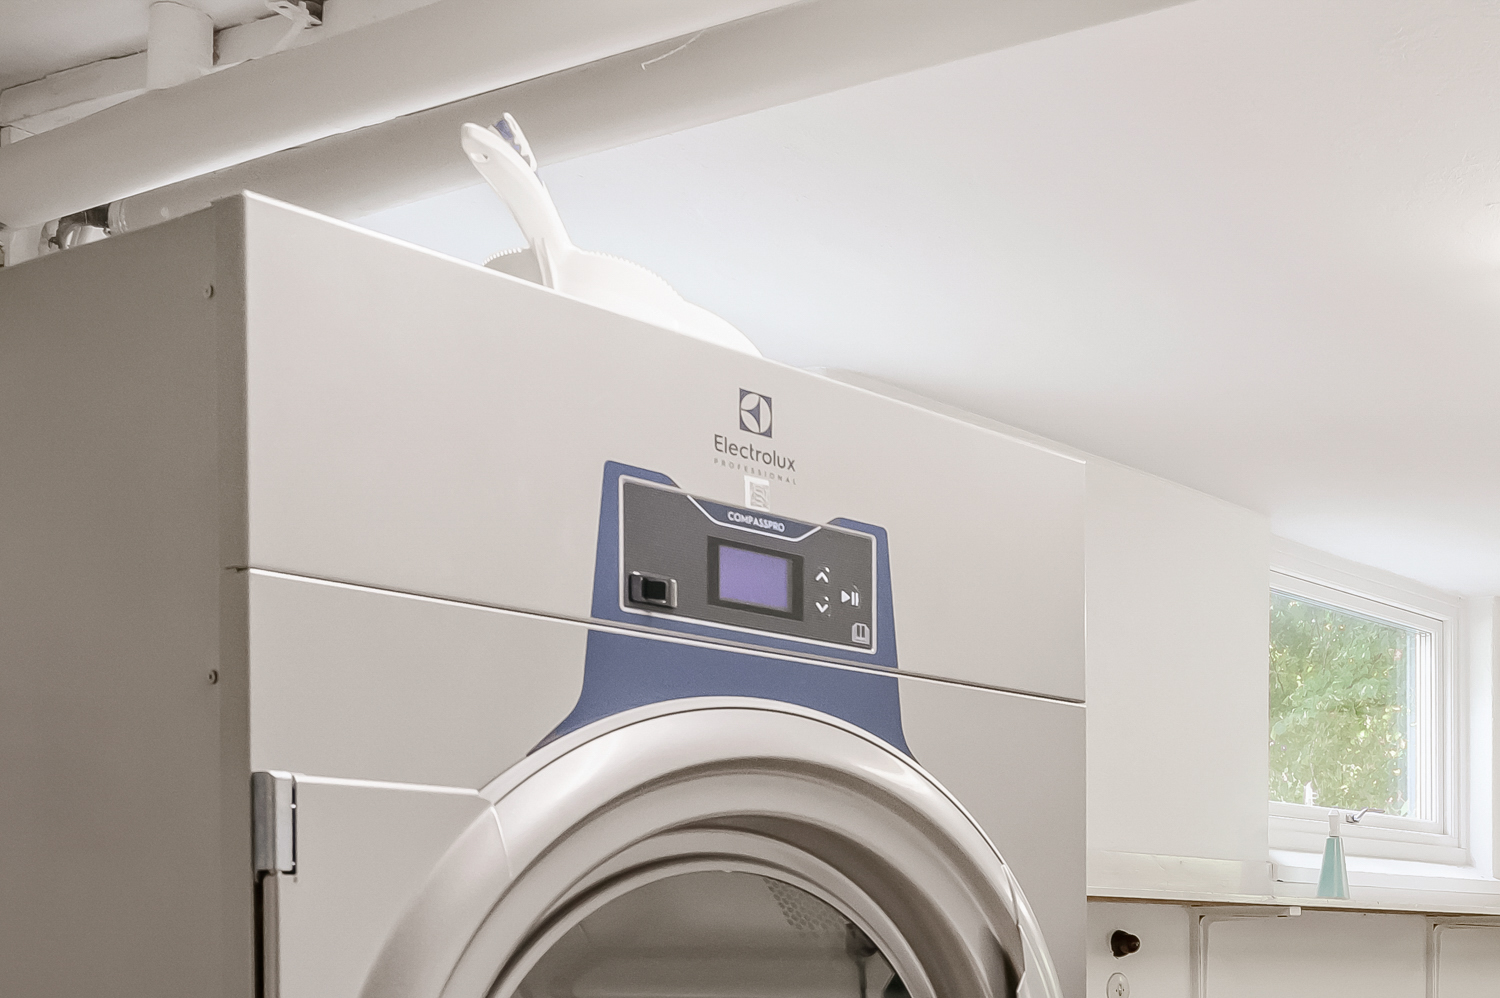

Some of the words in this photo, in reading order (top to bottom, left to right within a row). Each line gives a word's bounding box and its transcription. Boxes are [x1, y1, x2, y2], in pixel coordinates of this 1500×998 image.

[714, 433, 796, 472] Electrolux
[713, 458, 797, 486] PROFESSIONAL
[727, 511, 785, 533] COMPASSPRO
